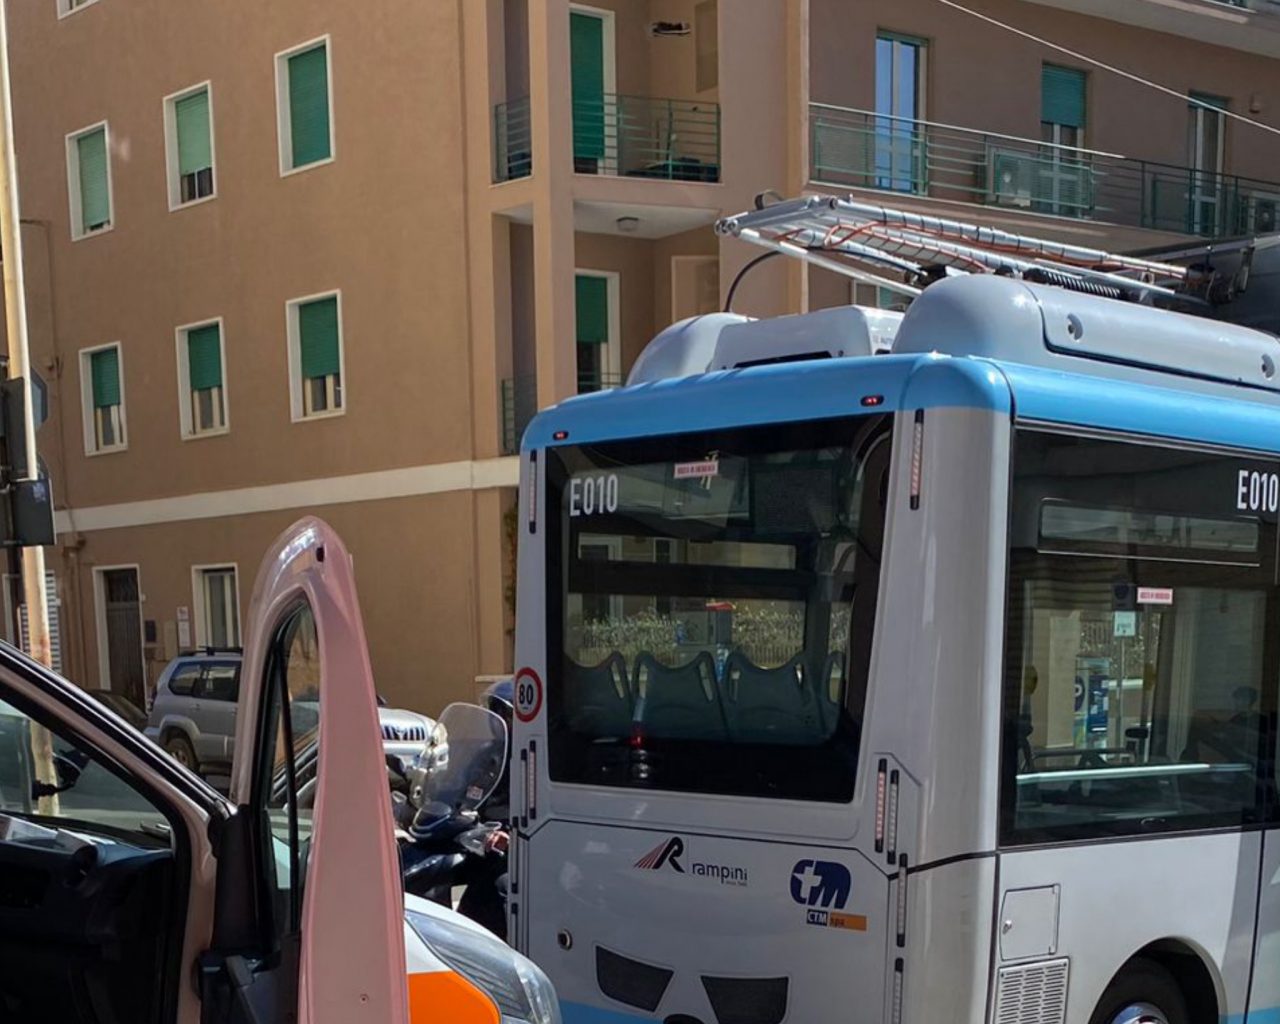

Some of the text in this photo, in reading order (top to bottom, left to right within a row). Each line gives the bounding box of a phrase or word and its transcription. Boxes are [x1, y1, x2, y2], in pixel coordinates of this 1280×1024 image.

[570, 474, 618, 516] E010
[1237, 470, 1279, 512] E010
[519, 684, 534, 705] 80
[692, 862, 748, 885] rampini
[807, 911, 828, 924] CTM
